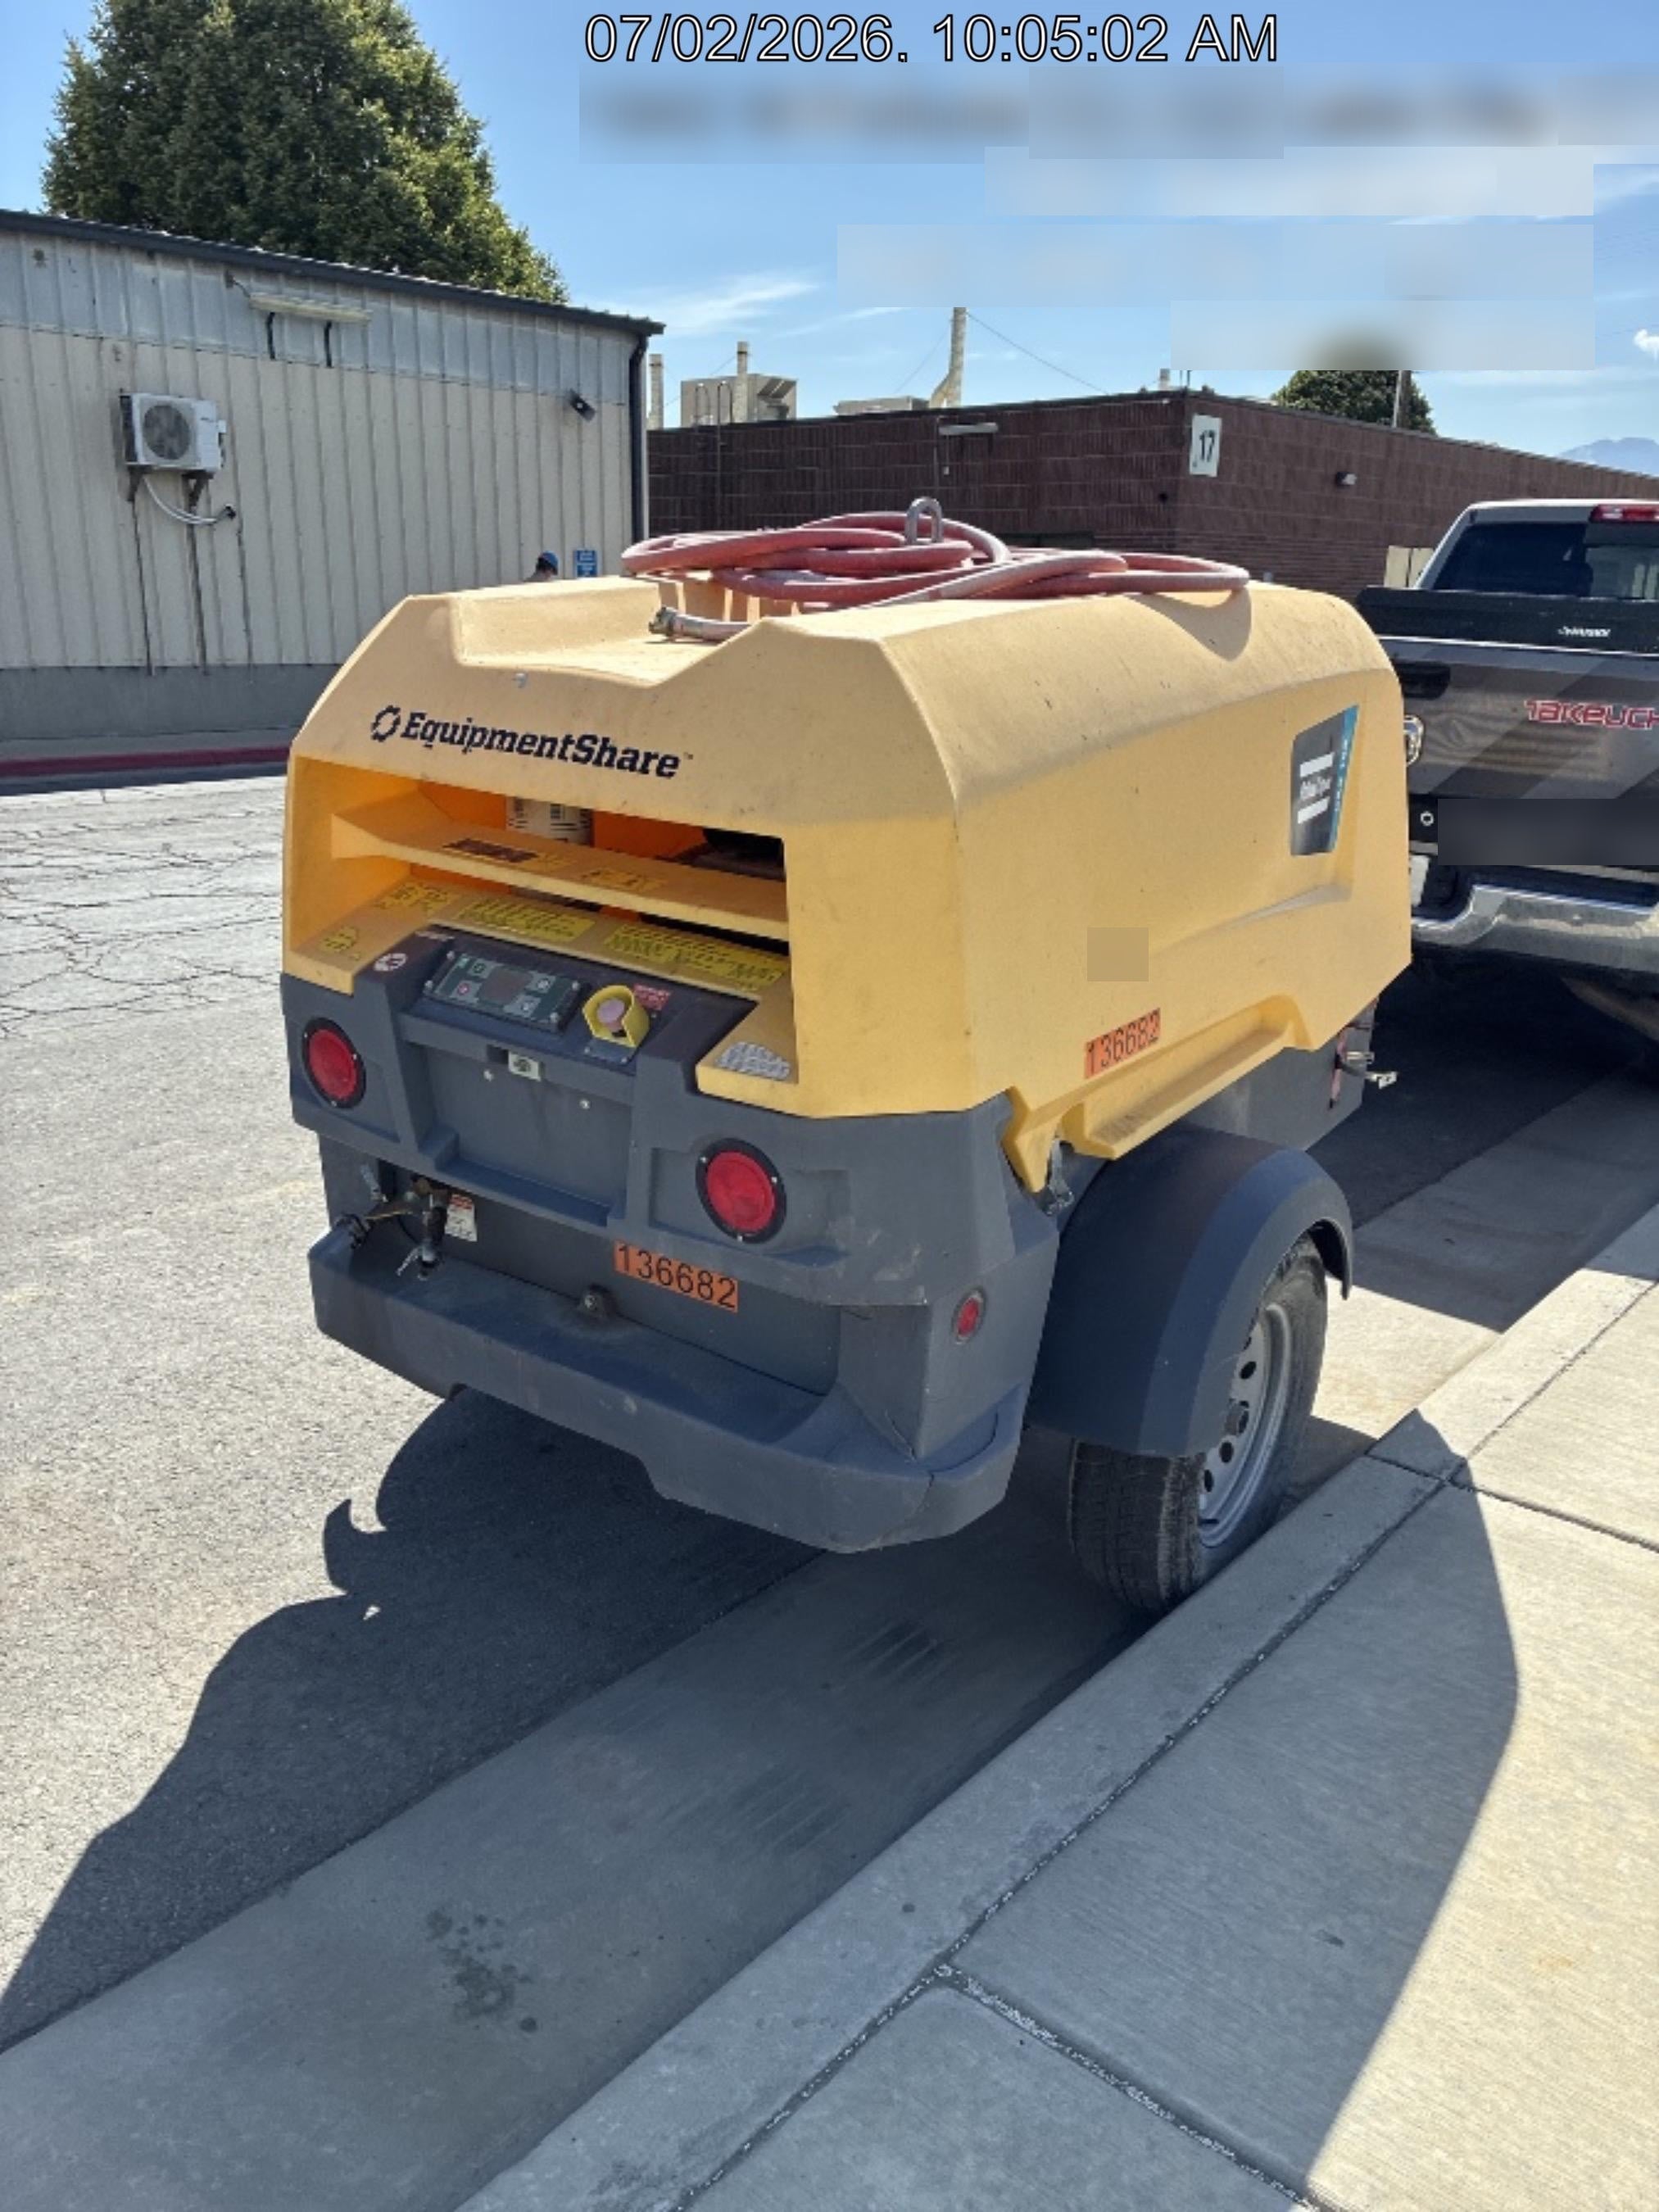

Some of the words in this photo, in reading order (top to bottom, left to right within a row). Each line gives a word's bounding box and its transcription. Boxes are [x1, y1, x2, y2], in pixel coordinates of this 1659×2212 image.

[1199, 430, 1215, 462] 17
[400, 711, 681, 779] EquipmentShare
[1087, 1009, 1159, 1075] 136682
[618, 1244, 735, 1308] 136682
